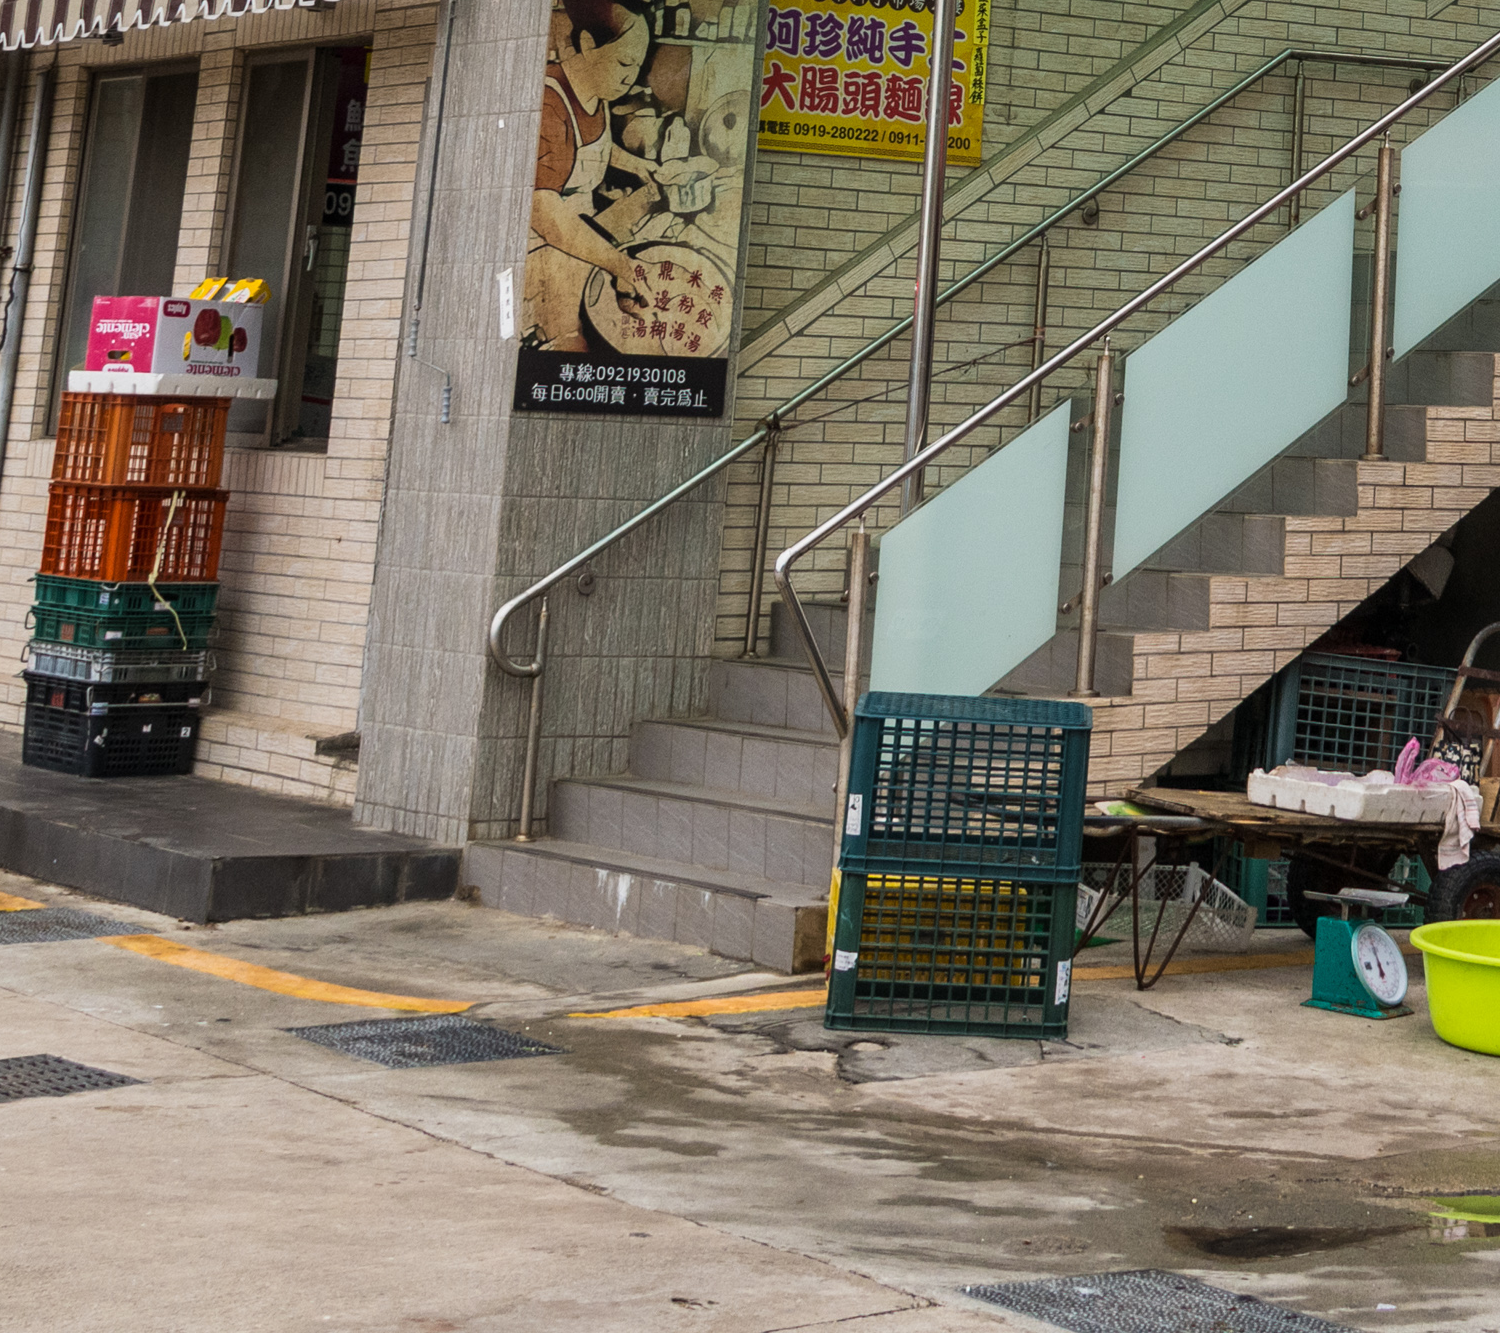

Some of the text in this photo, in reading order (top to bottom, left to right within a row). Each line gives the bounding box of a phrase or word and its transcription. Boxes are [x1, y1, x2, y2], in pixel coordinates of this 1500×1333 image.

[793, 121, 880, 144] 0919-280222
[888, 131, 971, 151] 0911-200
[95, 321, 150, 337] clemente
[186, 363, 241, 377] clemente
